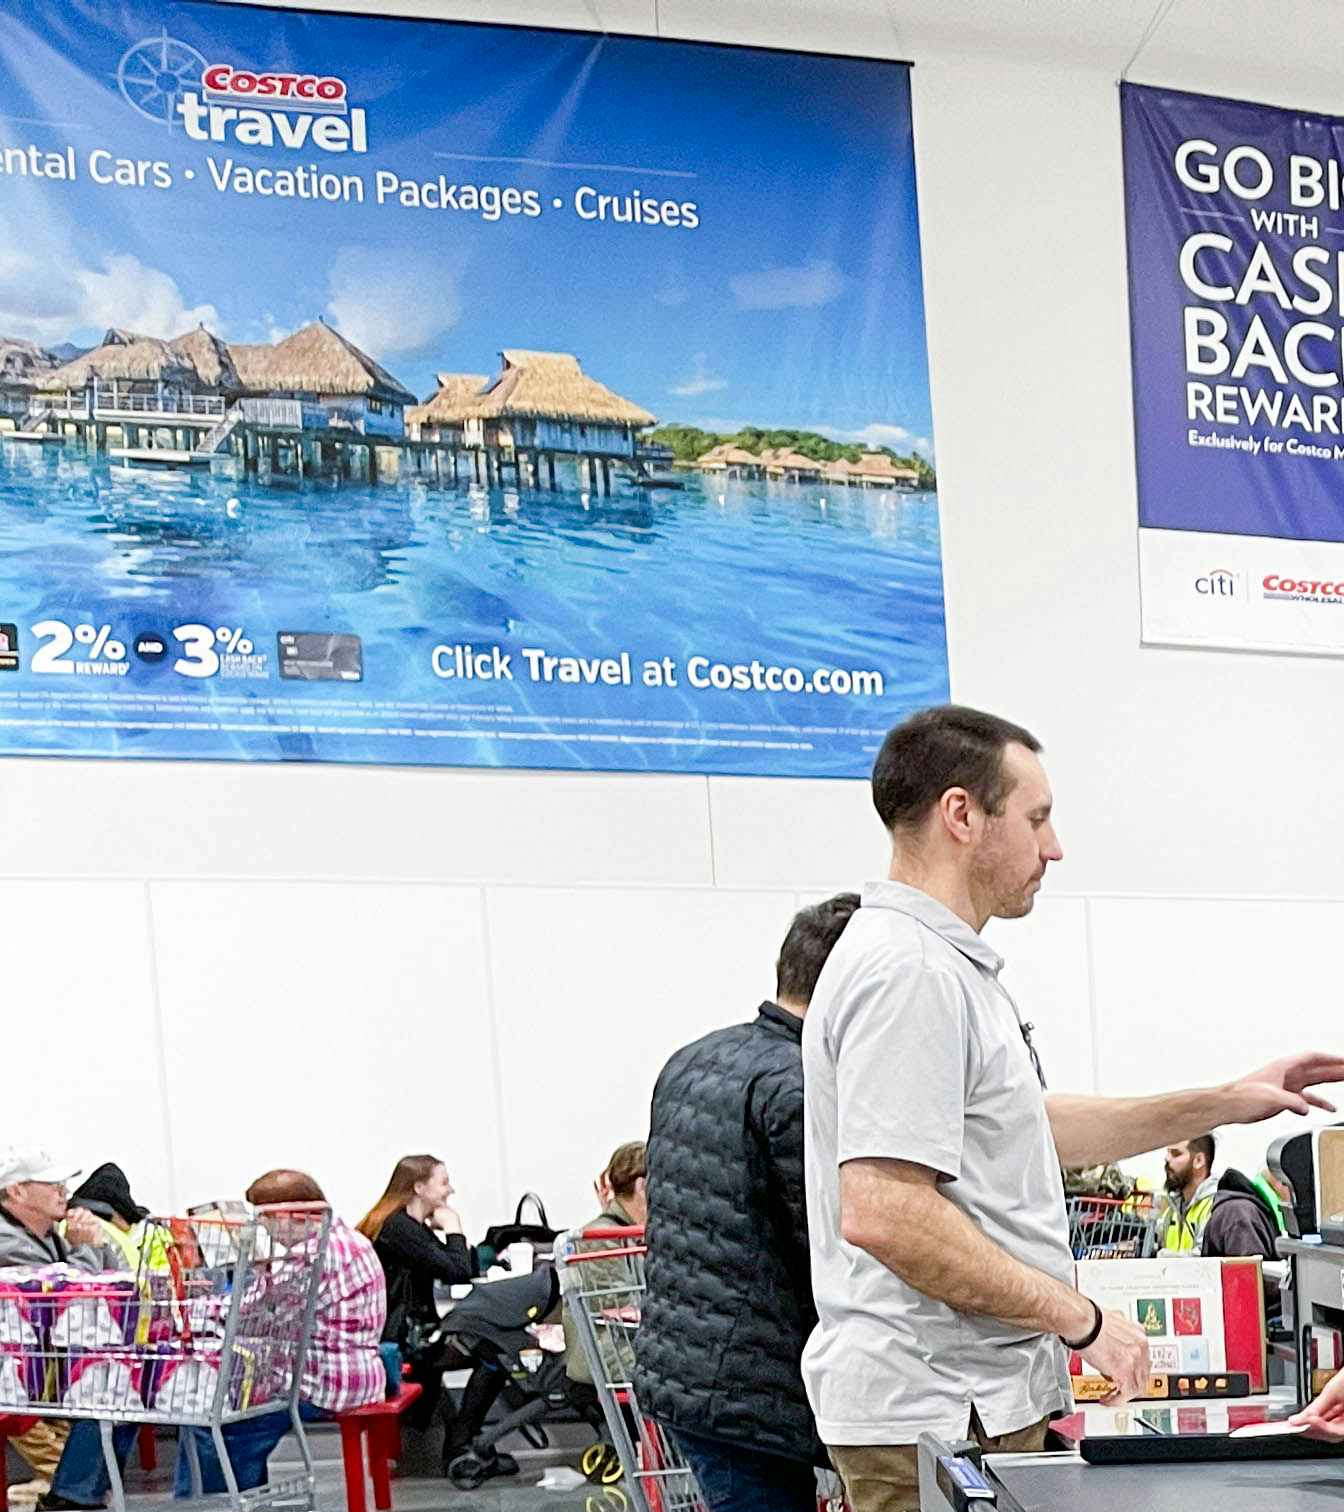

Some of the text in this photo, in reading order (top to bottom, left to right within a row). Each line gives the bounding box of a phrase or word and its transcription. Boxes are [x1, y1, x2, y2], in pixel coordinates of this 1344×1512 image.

[203, 66, 346, 100] COSTCO
[177, 93, 367, 152] travel
[0, 146, 699, 229] ntal Cars Vacation Packages Cruises
[1174, 139, 1274, 200] GO
[1251, 208, 1318, 239] WITH
[1188, 429, 1261, 456] Exclusively
[1263, 436, 1284, 453] for
[1286, 439, 1331, 460] Costco
[1195, 568, 1234, 596] citi
[30, 620, 127, 674] 2%
[172, 623, 254, 678] 3%
[431, 644, 884, 698] Click Travel at Costco.com
